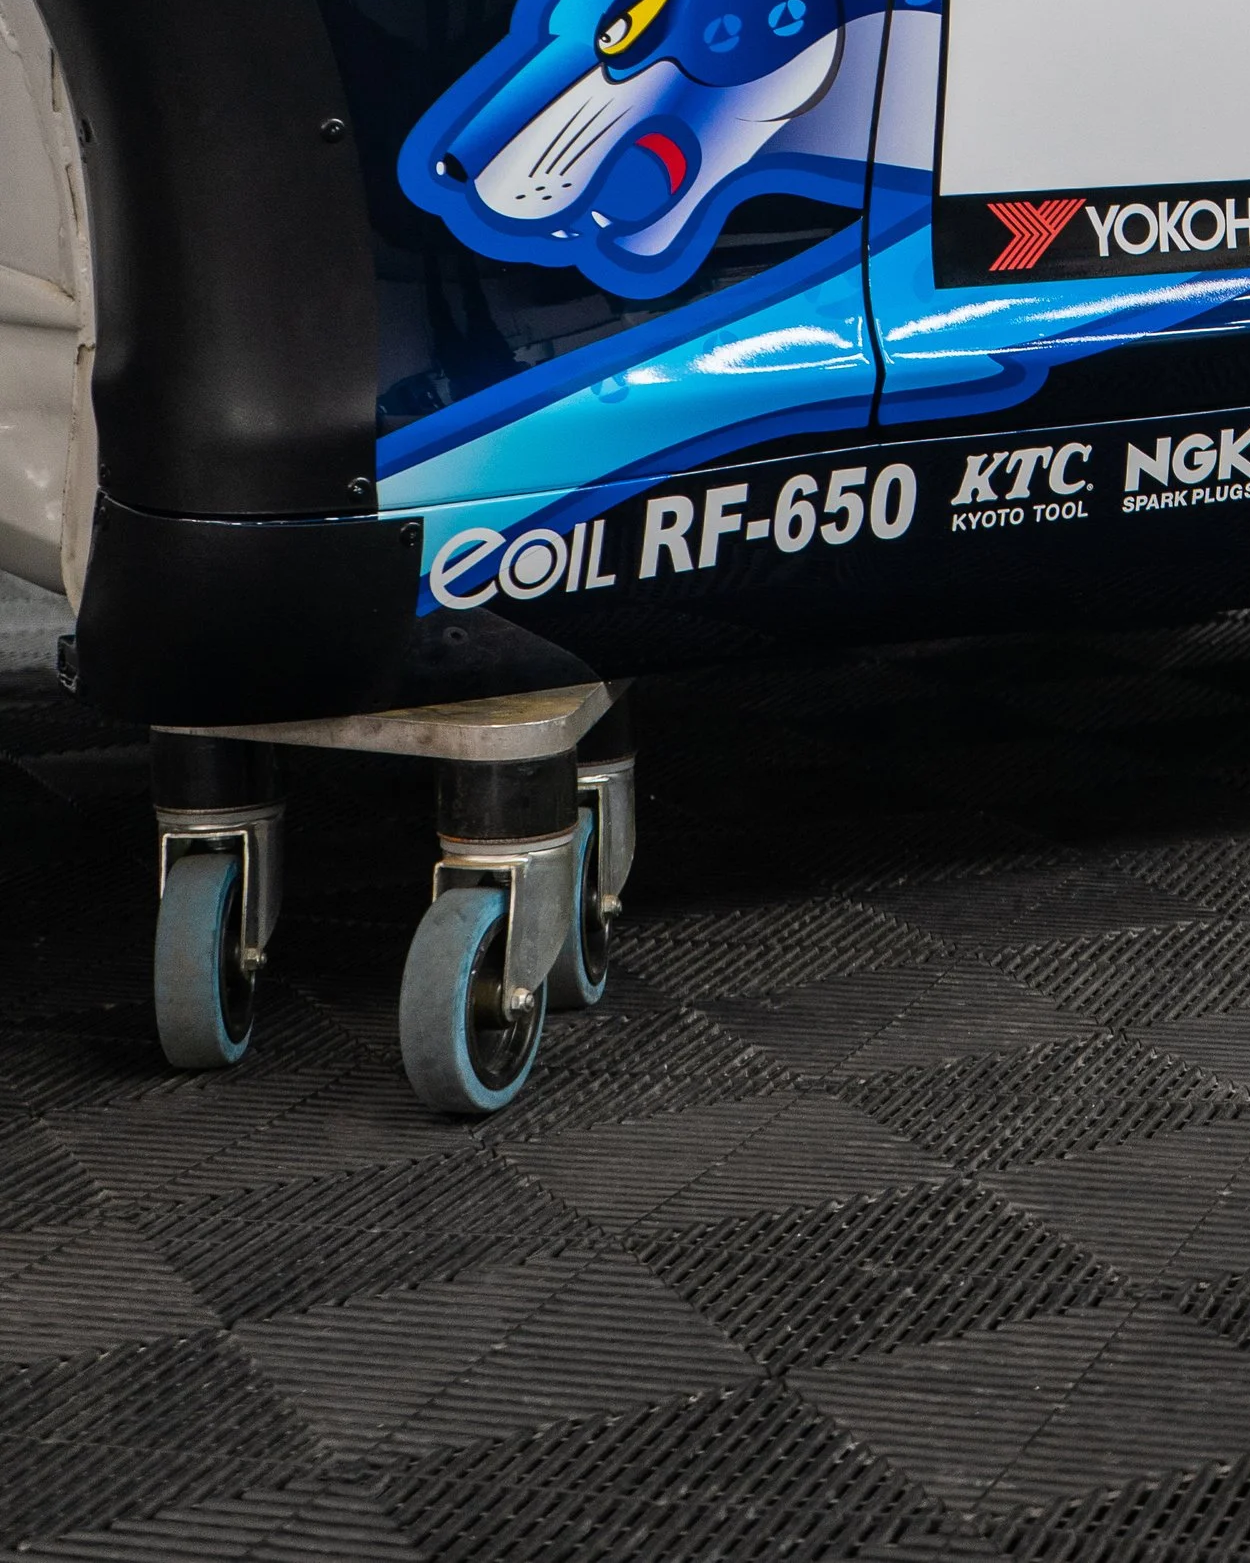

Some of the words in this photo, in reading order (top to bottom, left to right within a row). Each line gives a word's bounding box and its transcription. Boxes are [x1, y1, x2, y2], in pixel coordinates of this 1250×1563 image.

[951, 507, 1025, 532] KYOTO
[1033, 500, 1089, 523] TOOL
[1122, 489, 1188, 513] SPARK
[638, 463, 918, 579] RF-650
